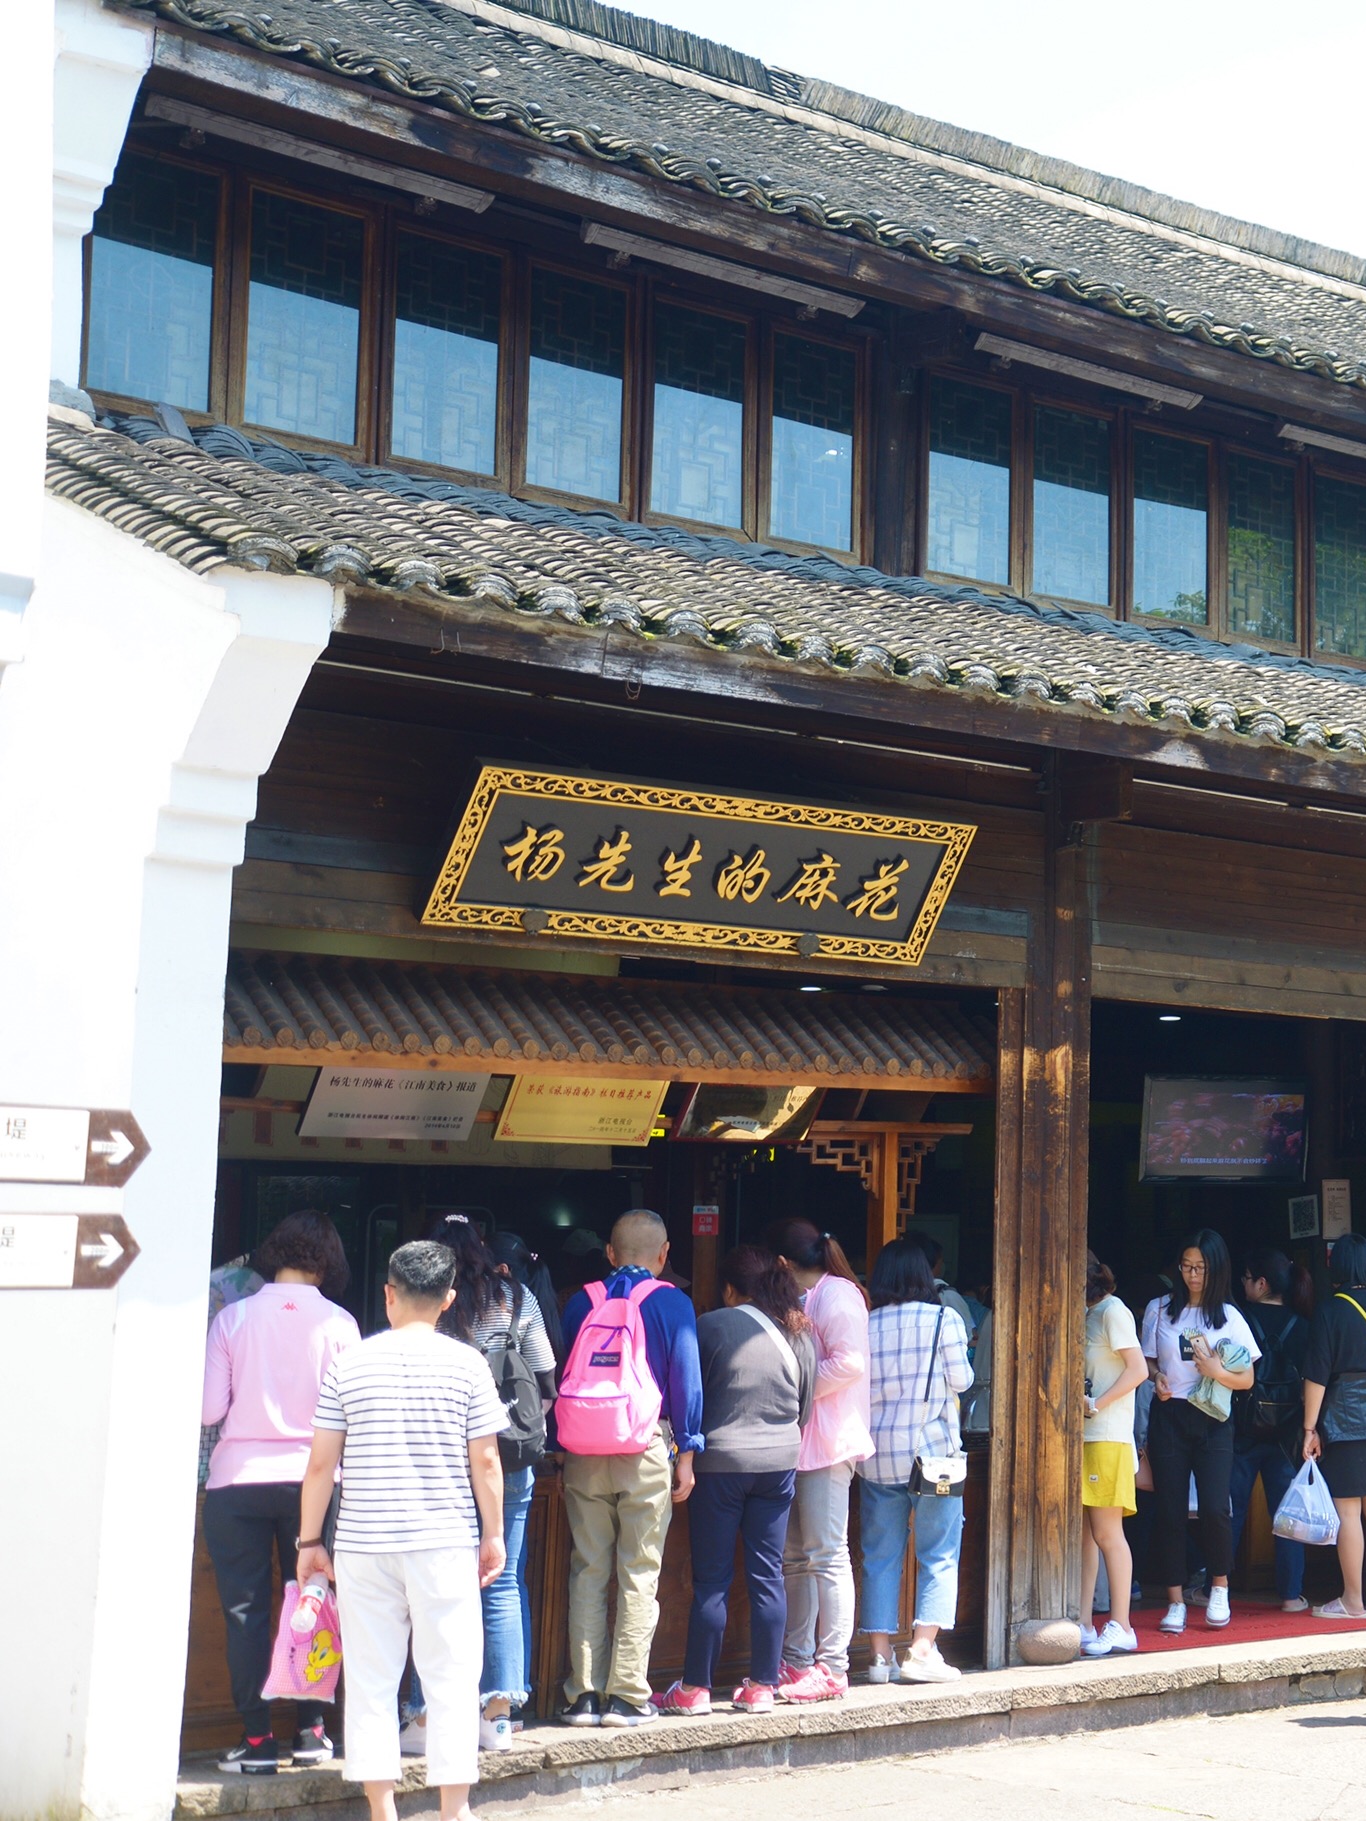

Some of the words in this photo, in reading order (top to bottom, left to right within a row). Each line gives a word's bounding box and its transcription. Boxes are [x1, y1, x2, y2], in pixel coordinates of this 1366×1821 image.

[503, 825, 910, 922] 杨先生的麻花
[329, 1075, 478, 1094] 杨先生的麻花《江南美食》报道
